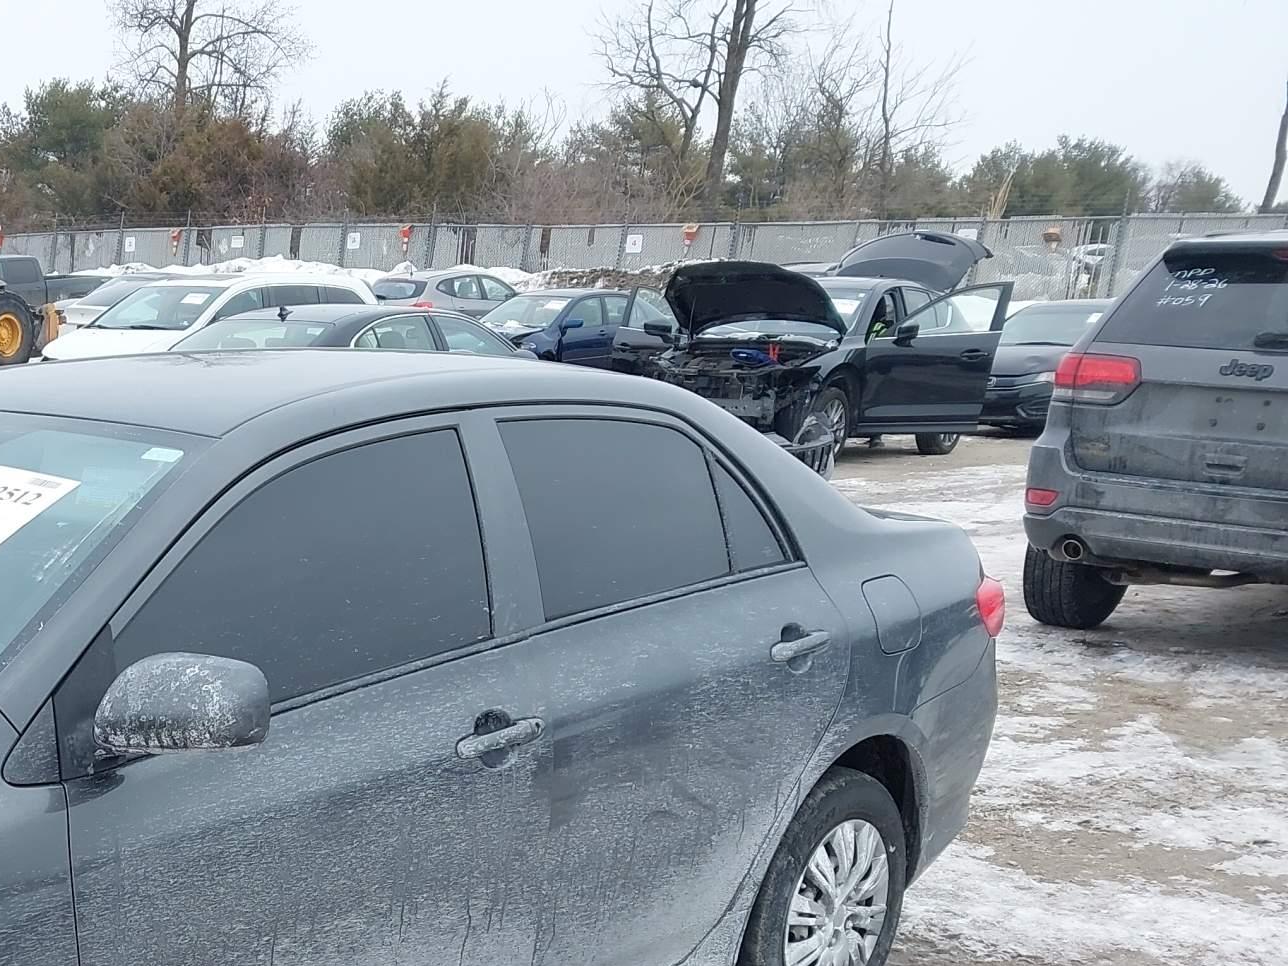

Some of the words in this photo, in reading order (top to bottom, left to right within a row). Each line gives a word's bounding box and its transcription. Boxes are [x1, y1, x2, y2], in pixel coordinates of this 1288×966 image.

[1165, 278, 1229, 291] 1-28-26
[1156, 294, 1213, 307] #059
[1220, 359, 1274, 381] Jeep
